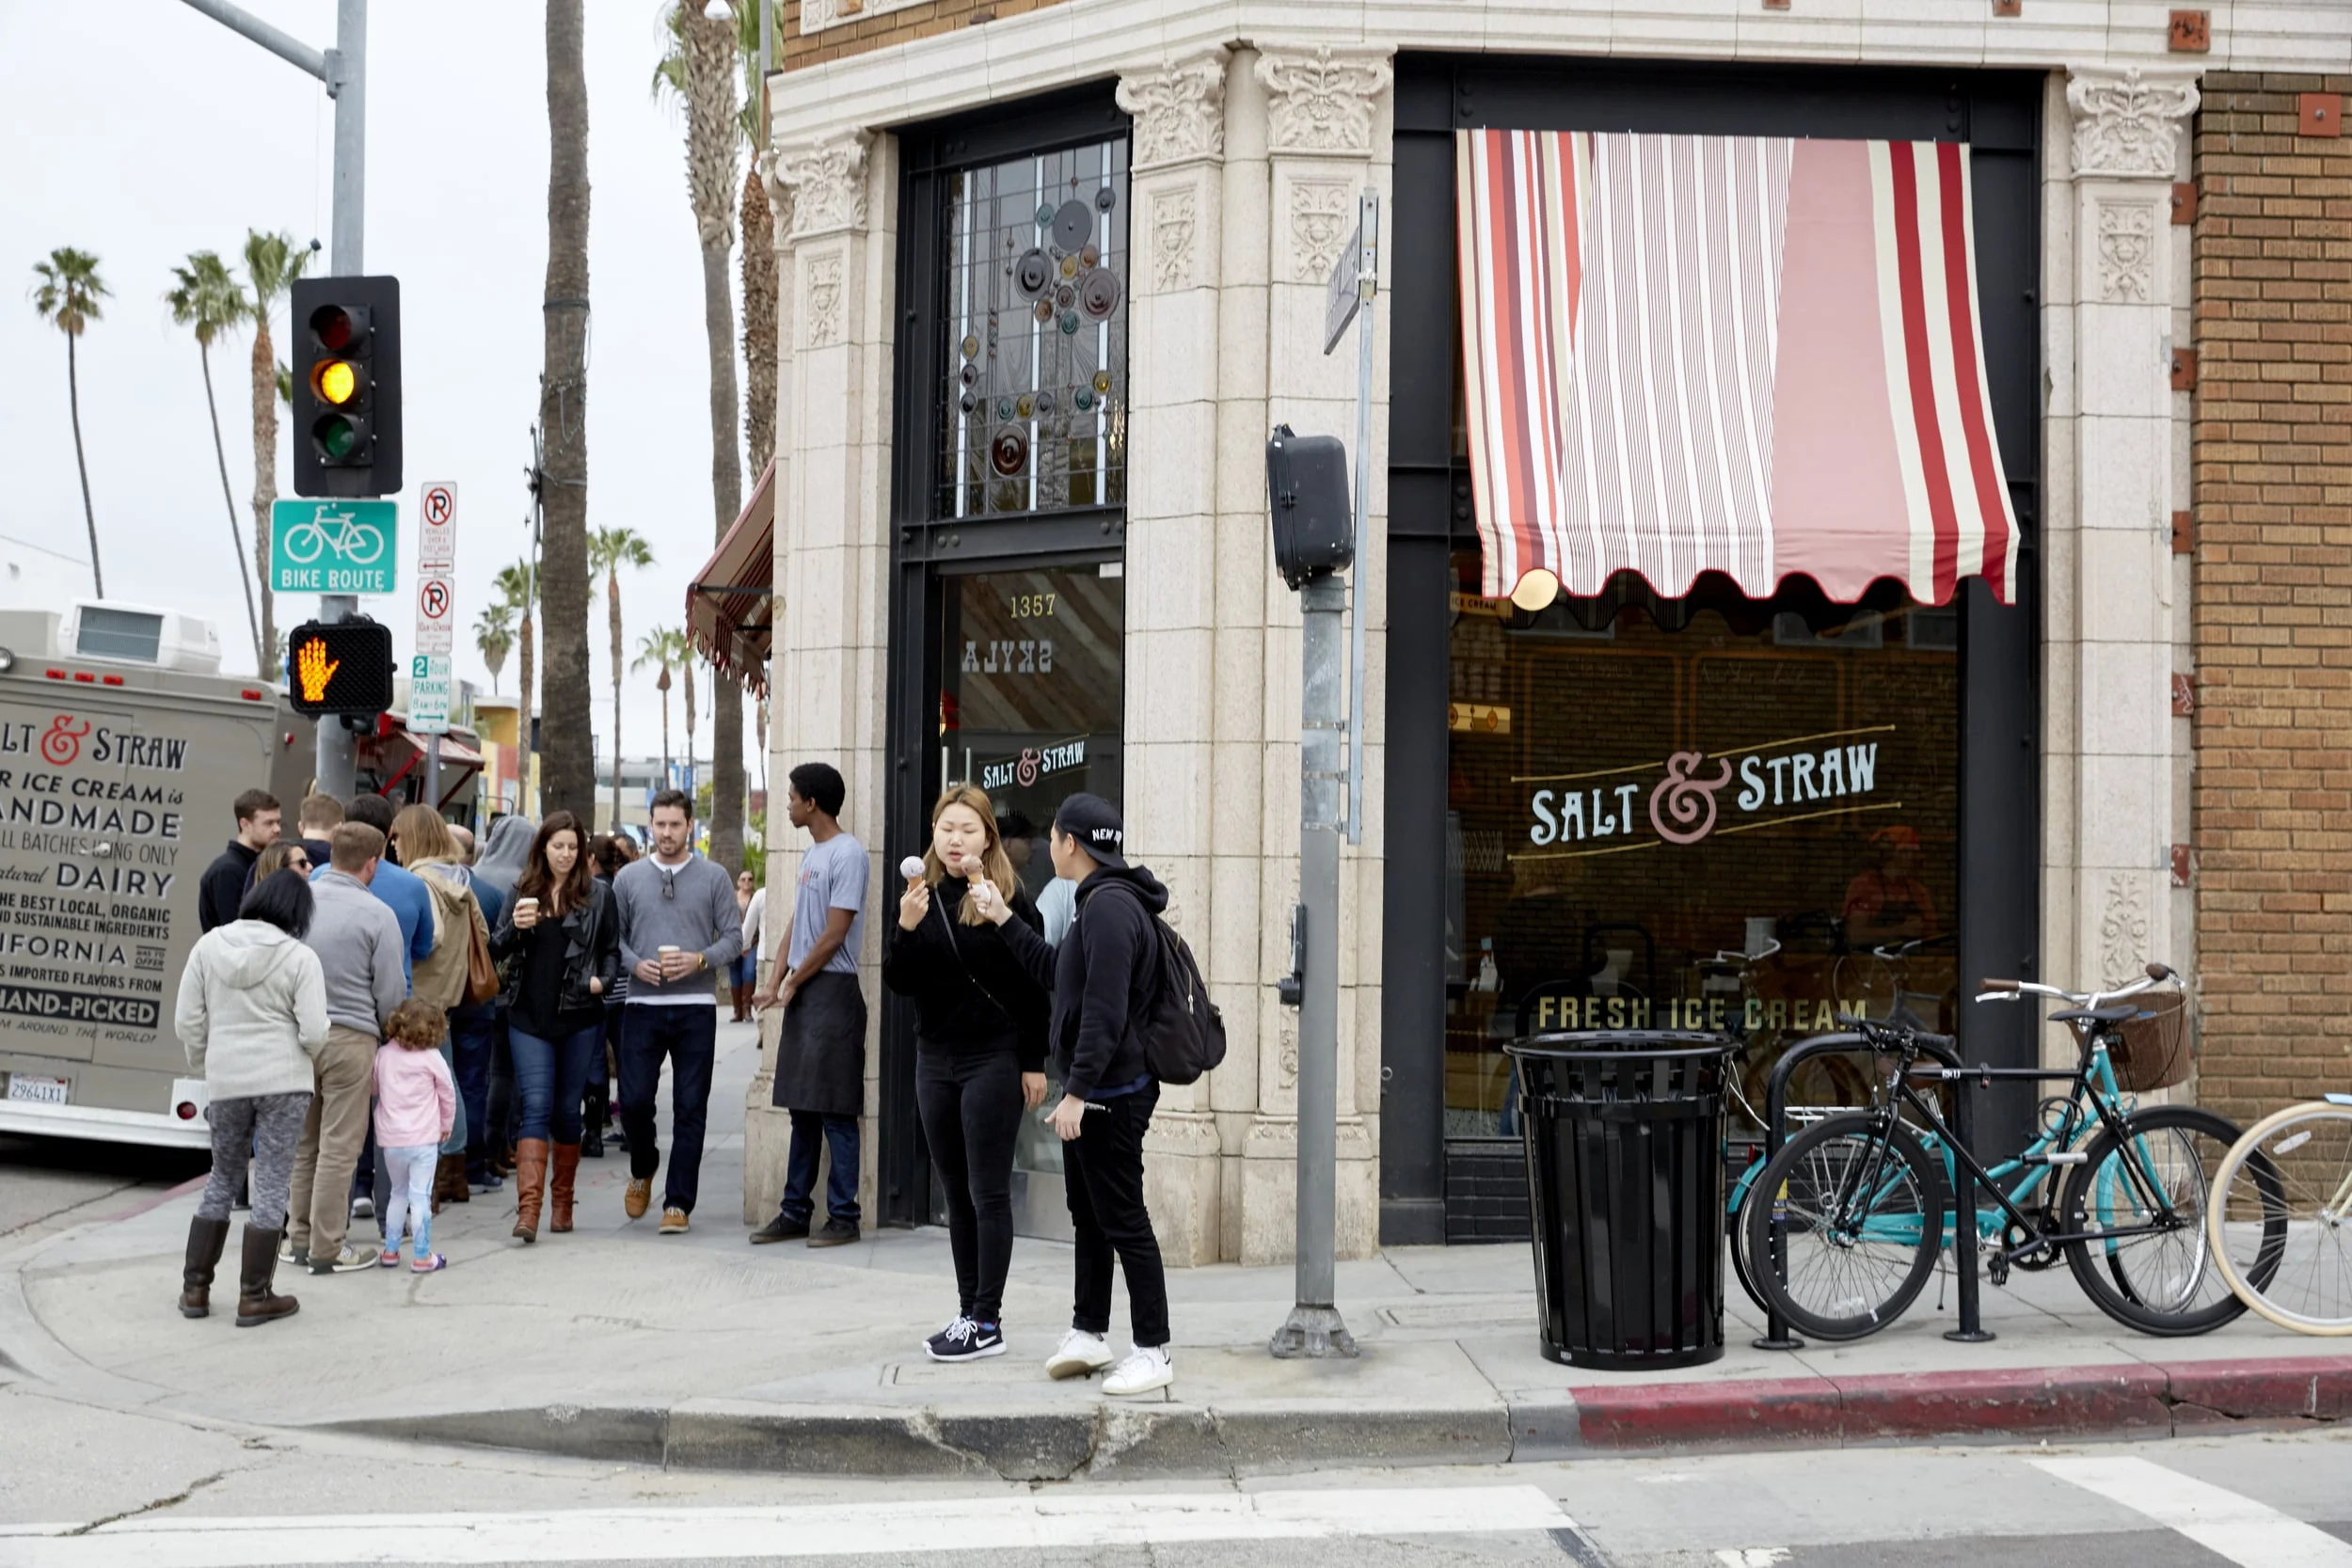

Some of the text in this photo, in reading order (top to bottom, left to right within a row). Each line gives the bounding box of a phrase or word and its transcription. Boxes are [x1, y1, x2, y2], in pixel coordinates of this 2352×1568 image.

[281, 569, 384, 589] BIKE ROUTE
[1010, 594, 1057, 618] 1357
[1468, 598, 1496, 610] CREAM
[415, 658, 449, 675] 2 HOUR
[414, 680, 449, 695] PARKING
[2, 715, 187, 771] LT & STRAW
[983, 741, 1085, 790] SALT & STRAW
[22, 772, 62, 793] ICE
[72, 777, 163, 804] CREAM
[167, 788, 184, 804] is
[1530, 742, 1878, 846] SALT & STRAW
[0, 797, 182, 839] NDMADE
[22, 832, 87, 856] BATCHES
[139, 844, 179, 866] ONLY
[1091, 828, 1114, 842] NEW
[56, 862, 173, 897] DAIRY
[21, 895, 56, 912] BEST
[59, 899, 106, 919] LOCAL,
[111, 904, 171, 924] ORGANIC
[14, 911, 90, 932] SUSTAINABLE
[94, 920, 169, 940] INGREDIENTS
[9, 966, 70, 984] IMPORTED
[72, 972, 124, 990] FLAVORS
[129, 977, 162, 993] FROM
[1539, 997, 1867, 1032] FRESH ICE CREAM
[16, 1021, 68, 1036] AROUND
[76, 1026, 98, 1039] THE
[104, 1029, 157, 1044] WORLD!
[12, 1084, 61, 1102] 29641X1
